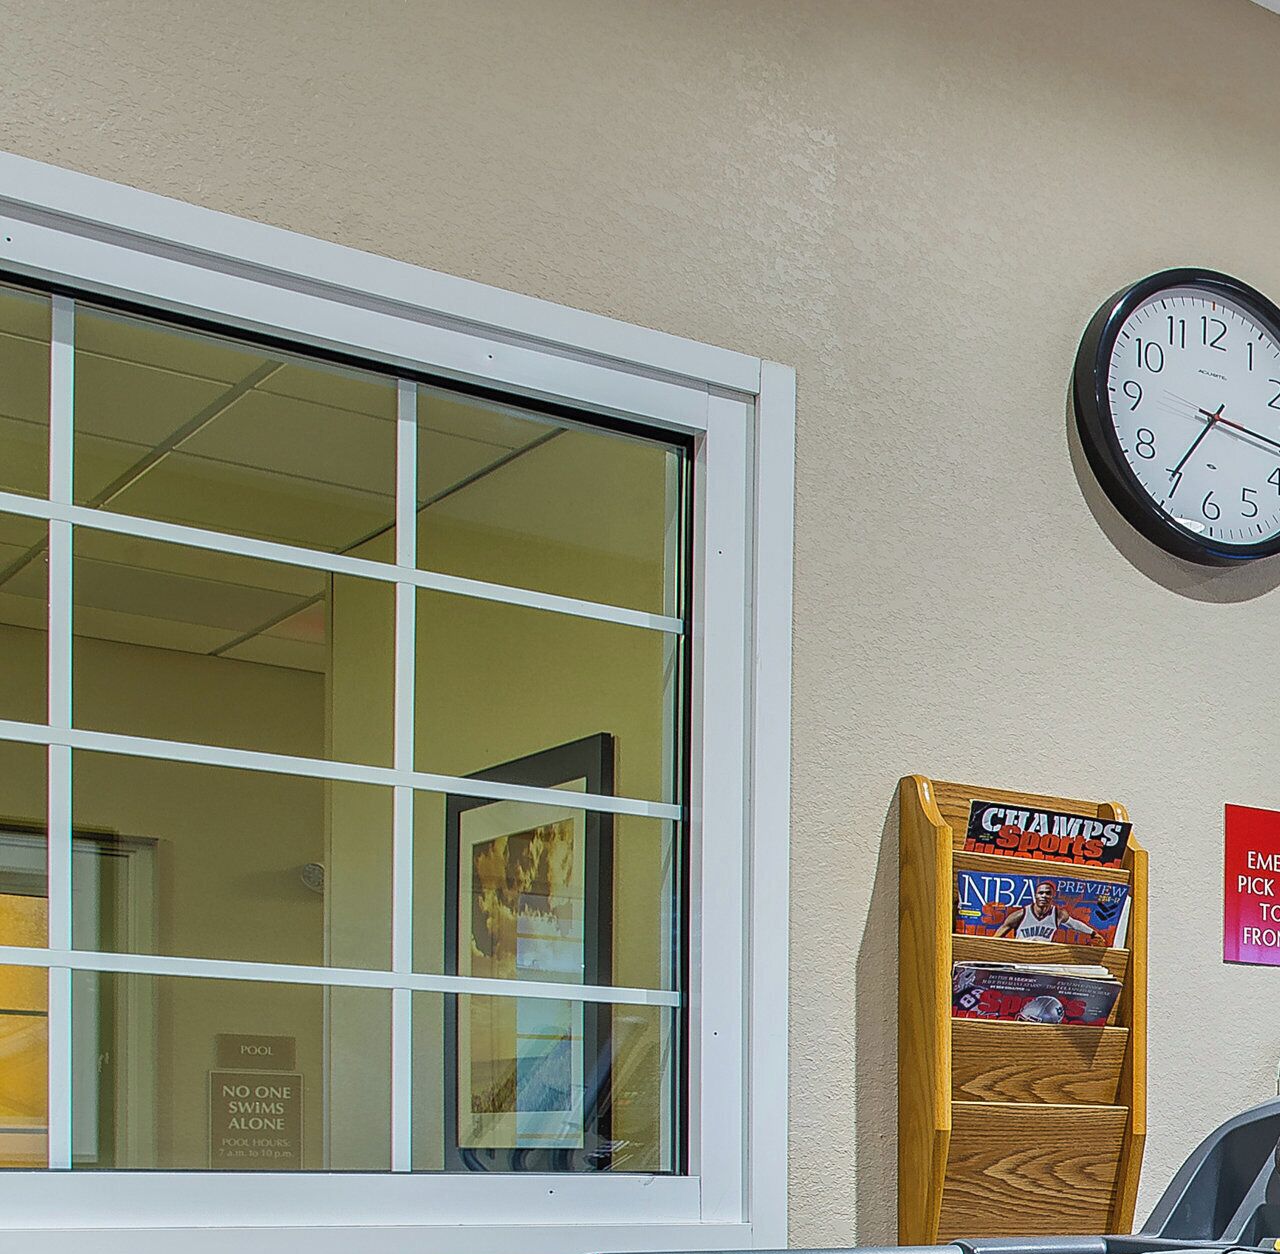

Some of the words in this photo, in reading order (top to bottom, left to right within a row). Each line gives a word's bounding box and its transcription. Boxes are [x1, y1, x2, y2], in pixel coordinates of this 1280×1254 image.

[1167, 315, 1185, 349] 11
[1201, 315, 1227, 351] 12
[1135, 337, 1164, 373] 10
[1246, 342, 1253, 371] 1
[1123, 380, 1143, 411] 9
[1135, 428, 1155, 459] 8
[1166, 468, 1183, 498] 7
[1202, 491, 1221, 520] 6
[1241, 488, 1258, 517] 5
[982, 807, 1122, 847] CHAMPS
[996, 825, 1104, 858] Sports
[960, 874, 1037, 908] NBA
[1056, 880, 1128, 897] PREVIEW
[1238, 875, 1274, 896] PICK
[240, 1045, 273, 1056] POOL
[222, 1085, 250, 1098] NO
[255, 1086, 291, 1099] ONE
[228, 1117, 285, 1130] ALONE
[222, 1138, 251, 1147] POOL
[253, 1138, 291, 1147] HOURS:
[249, 1149, 259, 1157] to
[261, 1149, 272, 1157] 10
